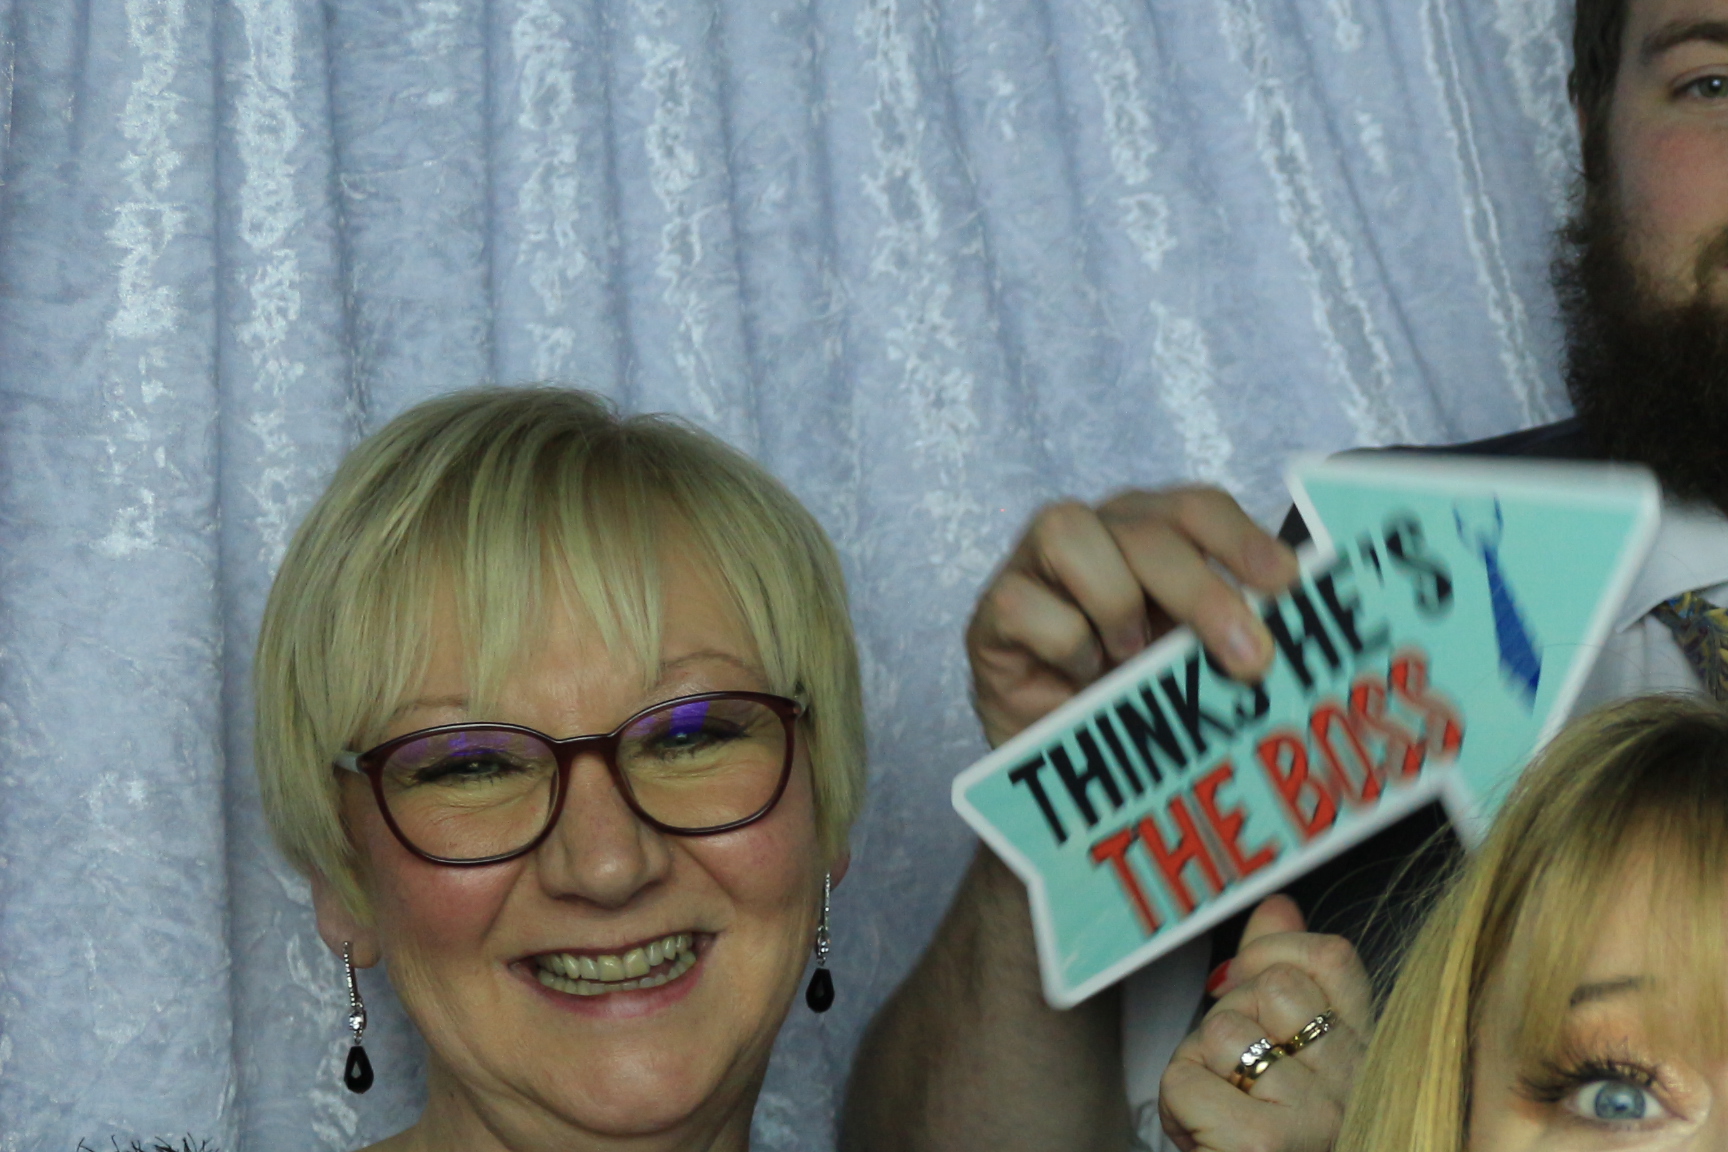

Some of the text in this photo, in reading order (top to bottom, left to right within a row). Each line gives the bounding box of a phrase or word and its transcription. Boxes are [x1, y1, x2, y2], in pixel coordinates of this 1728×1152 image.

[1262, 510, 1454, 690] HE'S
[1089, 643, 1466, 937] THE BOSS
